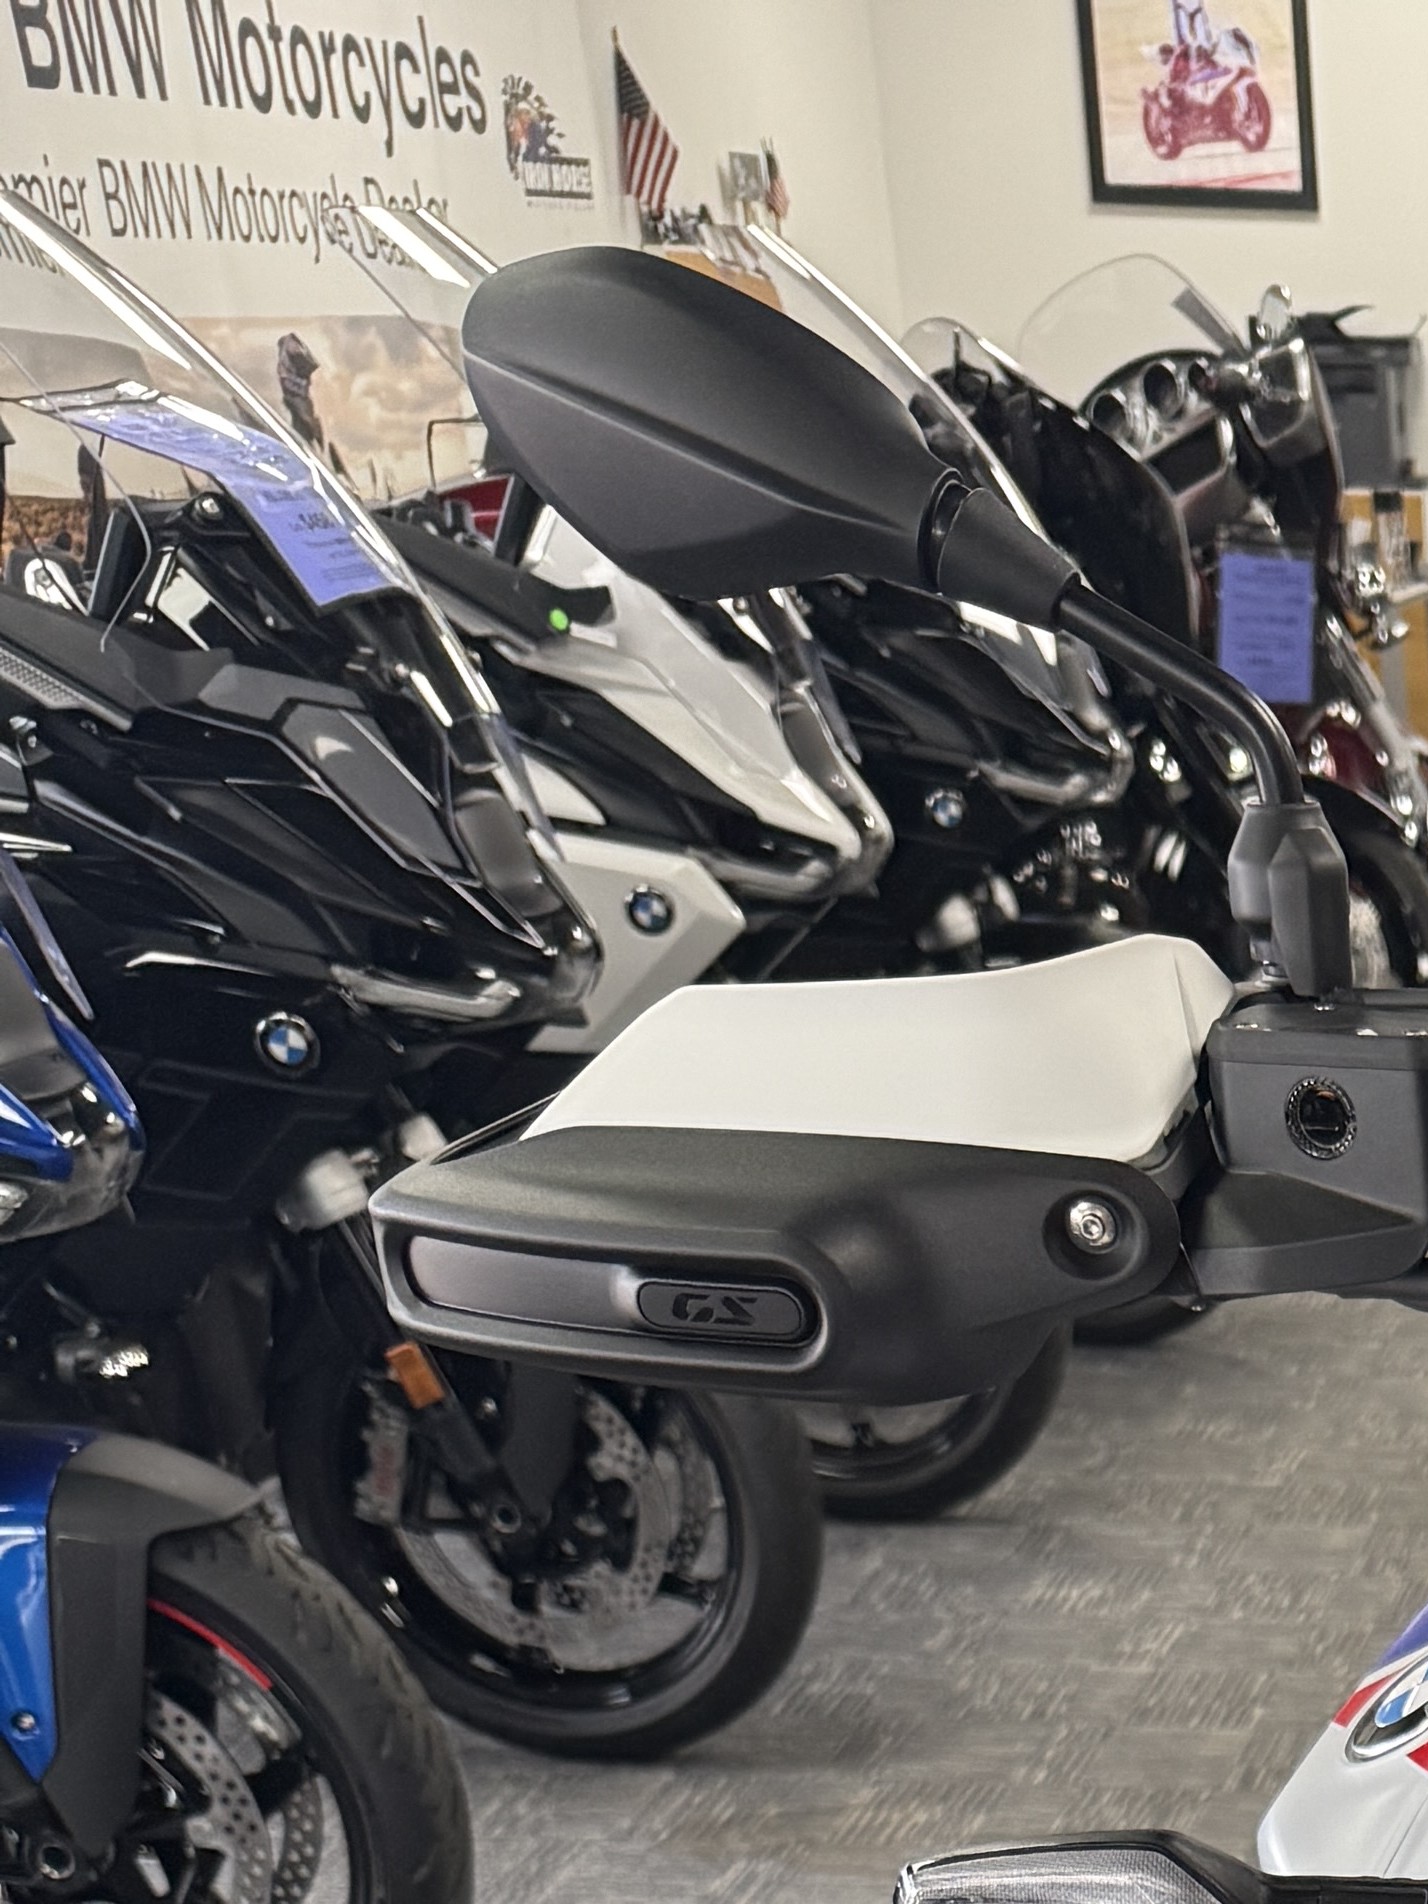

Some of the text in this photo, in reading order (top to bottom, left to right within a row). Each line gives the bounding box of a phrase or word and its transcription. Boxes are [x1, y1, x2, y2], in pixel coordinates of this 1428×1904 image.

[10, 0, 487, 158] BMW Motorcycles
[97, 157, 192, 240] BMW
[672, 1292, 758, 1327] GS
